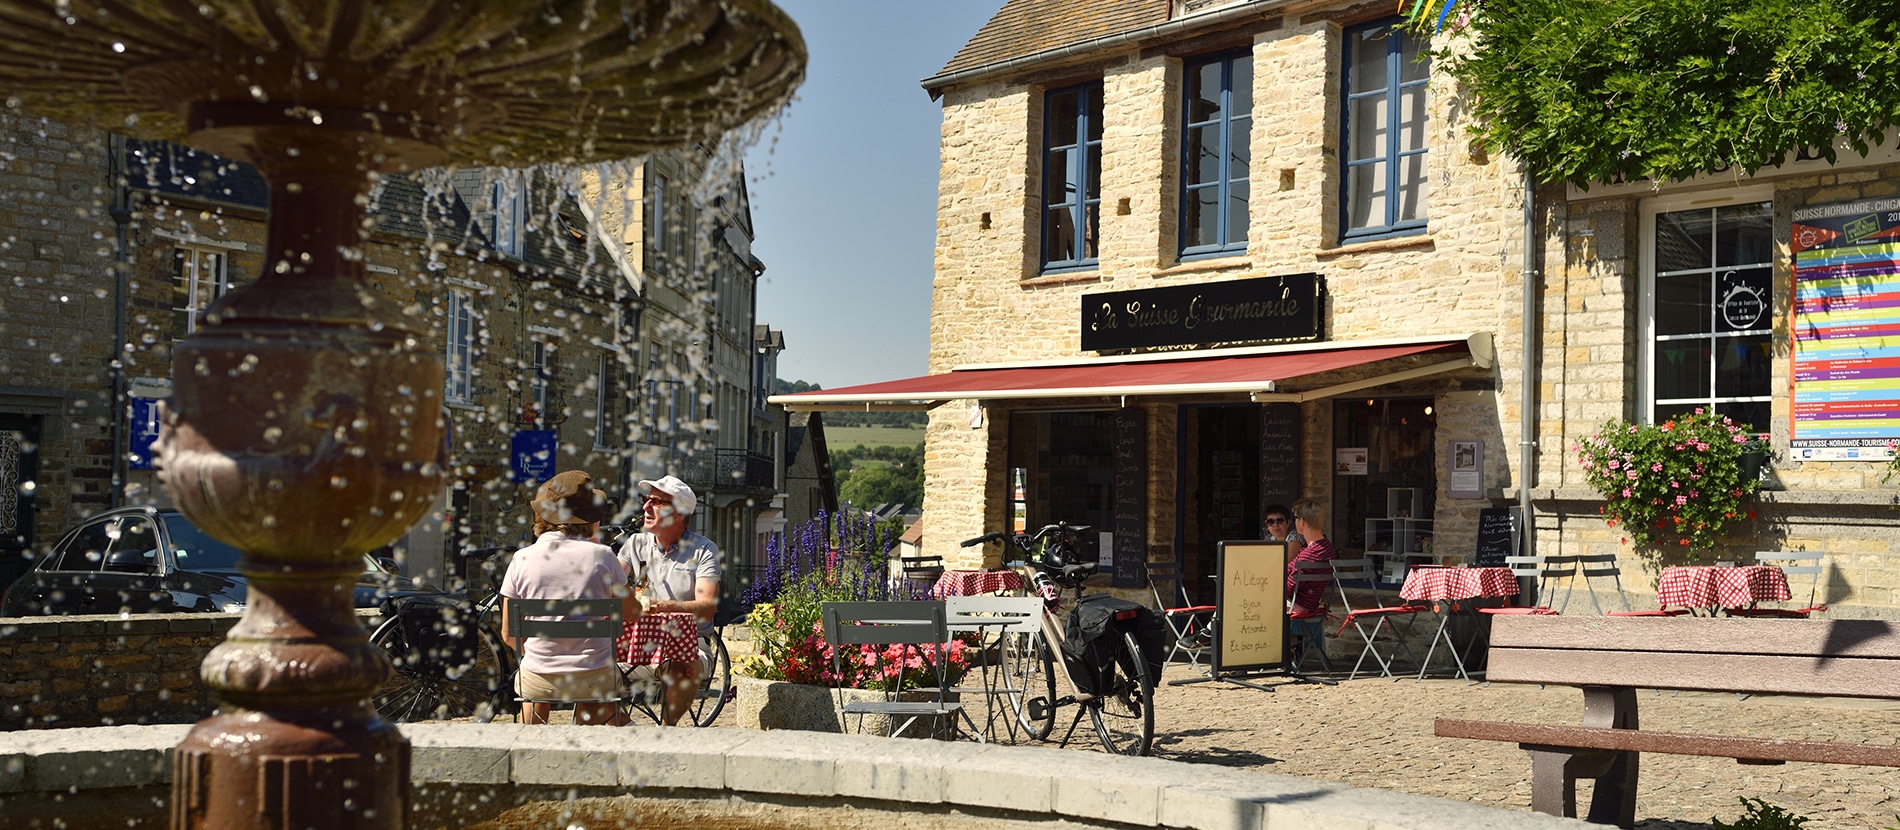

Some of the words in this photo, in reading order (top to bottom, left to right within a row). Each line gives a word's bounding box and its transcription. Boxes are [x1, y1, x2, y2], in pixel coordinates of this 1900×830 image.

[1795, 207, 1824, 220] SUISSE
[1825, 202, 1870, 217] NORMANDE
[1091, 302, 1119, 332] La
[1126, 299, 1180, 329] Suisse
[1184, 284, 1301, 331] Gourmande
[1232, 570, 1242, 586] A
